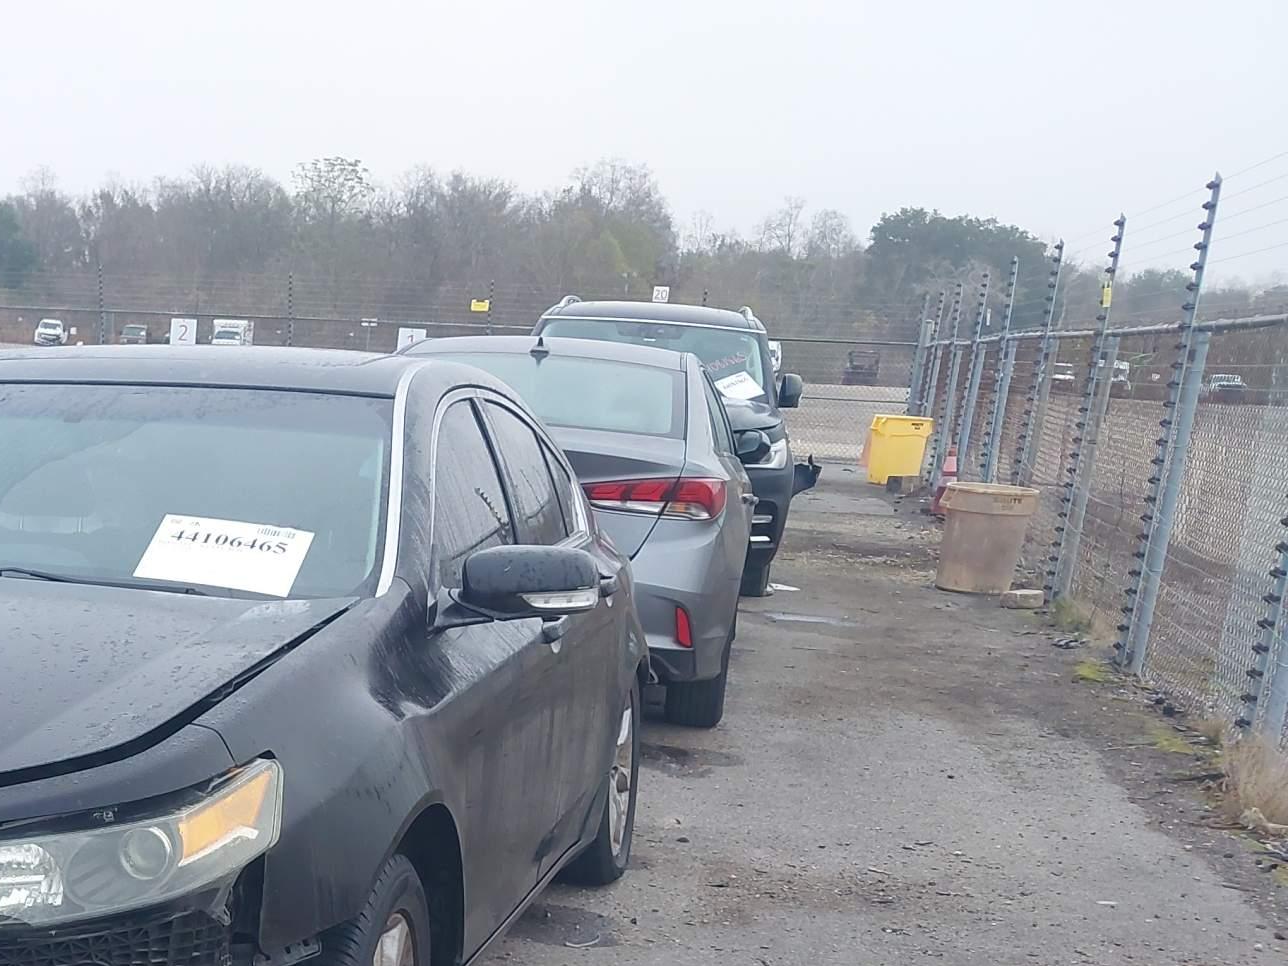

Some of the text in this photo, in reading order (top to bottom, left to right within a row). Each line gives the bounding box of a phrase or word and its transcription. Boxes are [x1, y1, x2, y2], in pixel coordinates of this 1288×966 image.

[654, 288, 668, 300] 20
[178, 324, 188, 341] 2
[170, 529, 289, 555] 44106465
